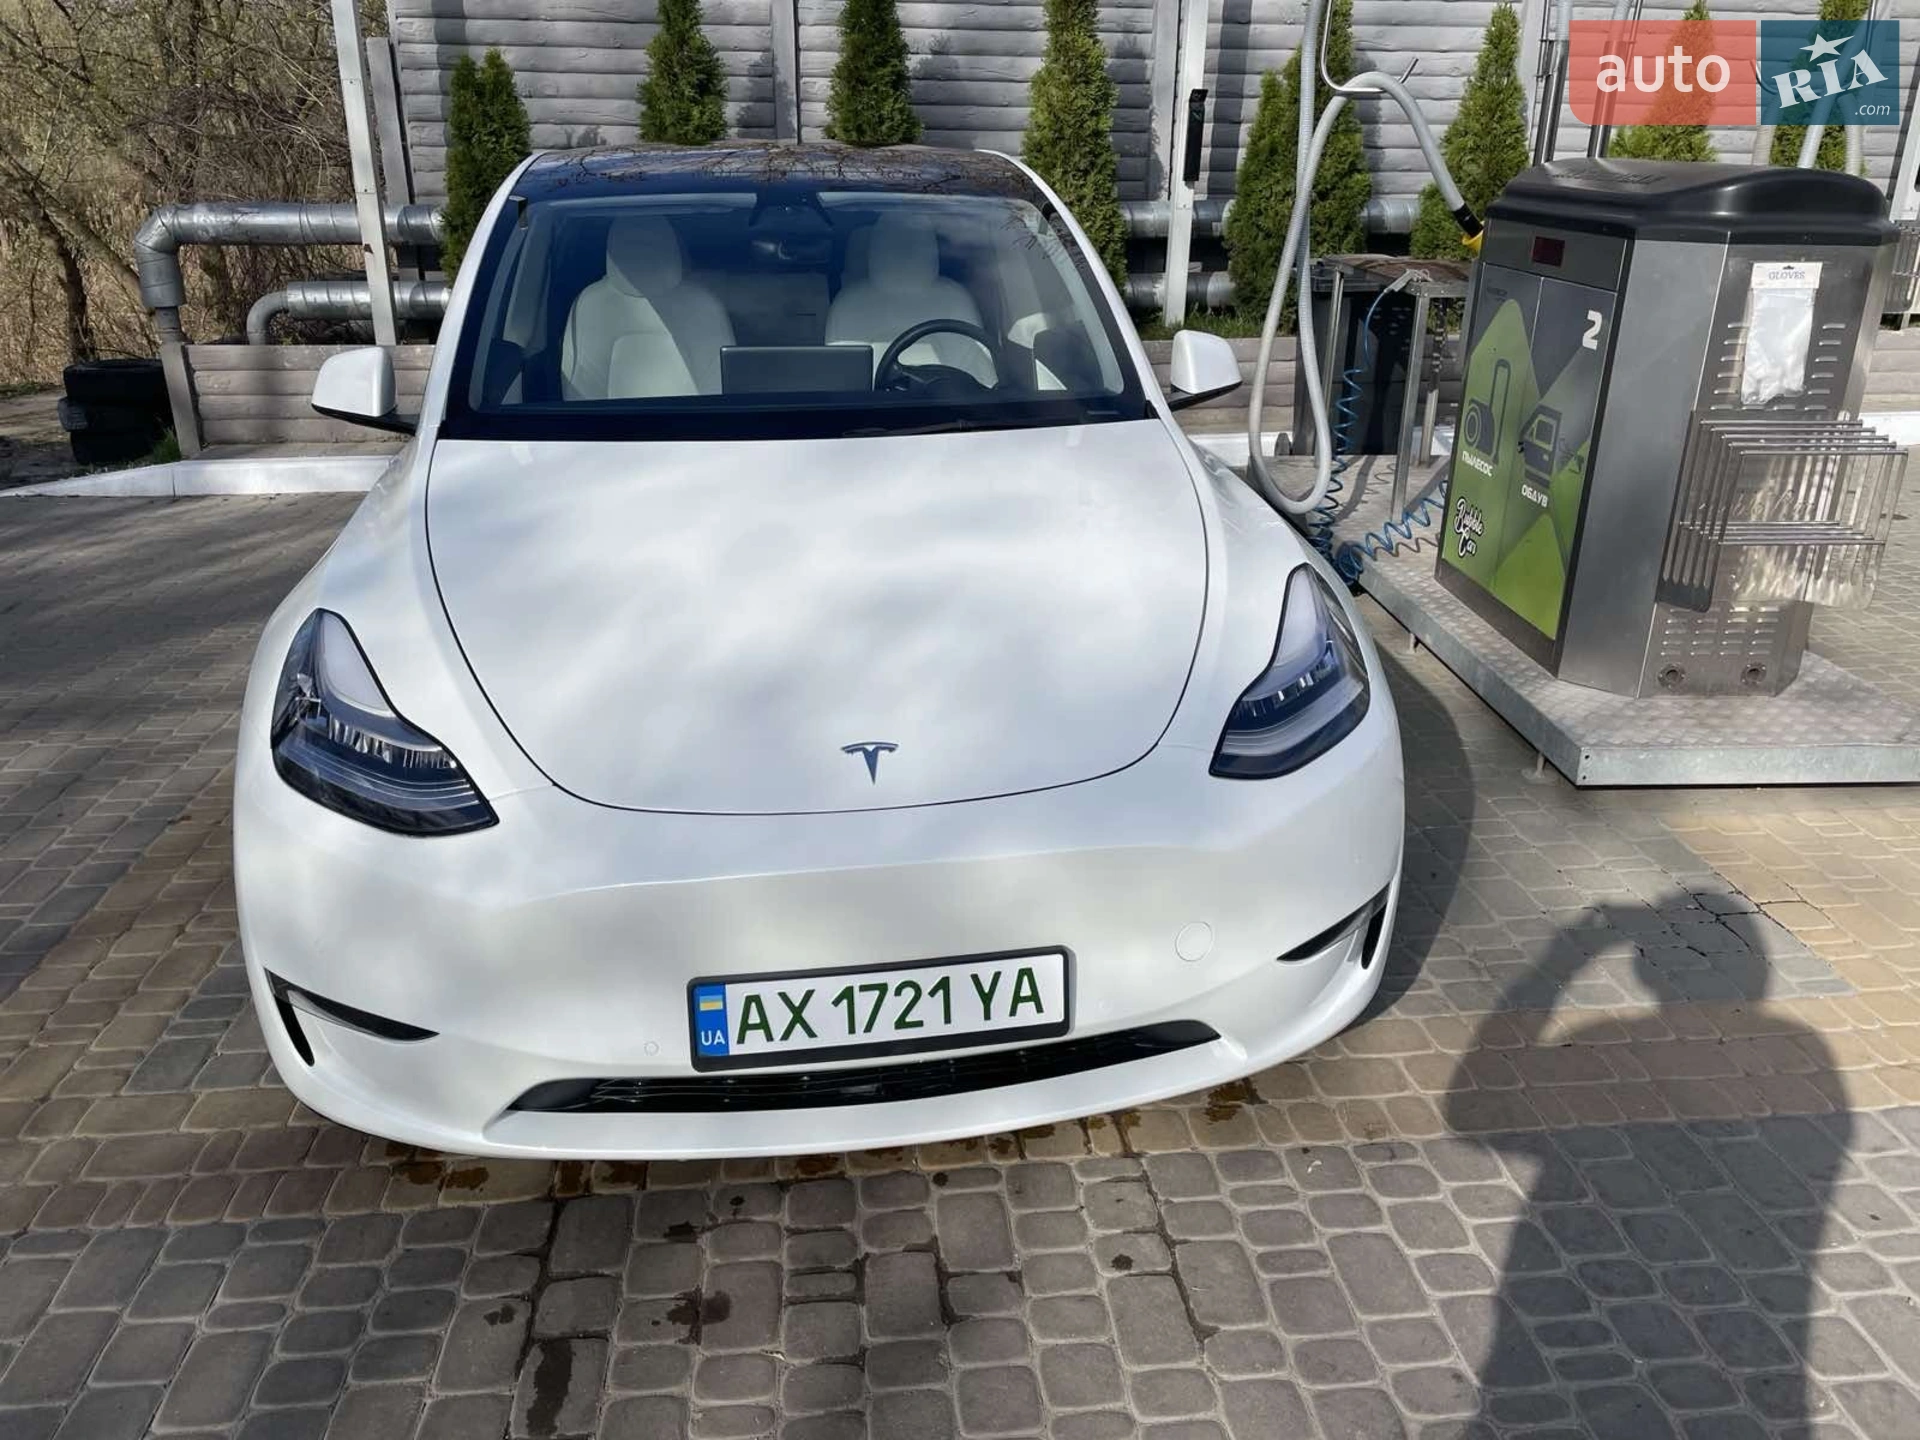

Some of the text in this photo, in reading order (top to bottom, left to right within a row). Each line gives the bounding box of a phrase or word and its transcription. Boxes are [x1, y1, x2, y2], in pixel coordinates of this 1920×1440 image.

[1768, 270, 1806, 281] GLOVES
[1582, 309, 1603, 351] 2
[1462, 450, 1494, 477] ПЫЛЕСОС
[1521, 484, 1549, 508] ОБДУВ
[1454, 497, 1484, 536] Bubble
[736, 967, 1044, 1045] AX 1721 YA
[701, 1030, 726, 1047] UA
